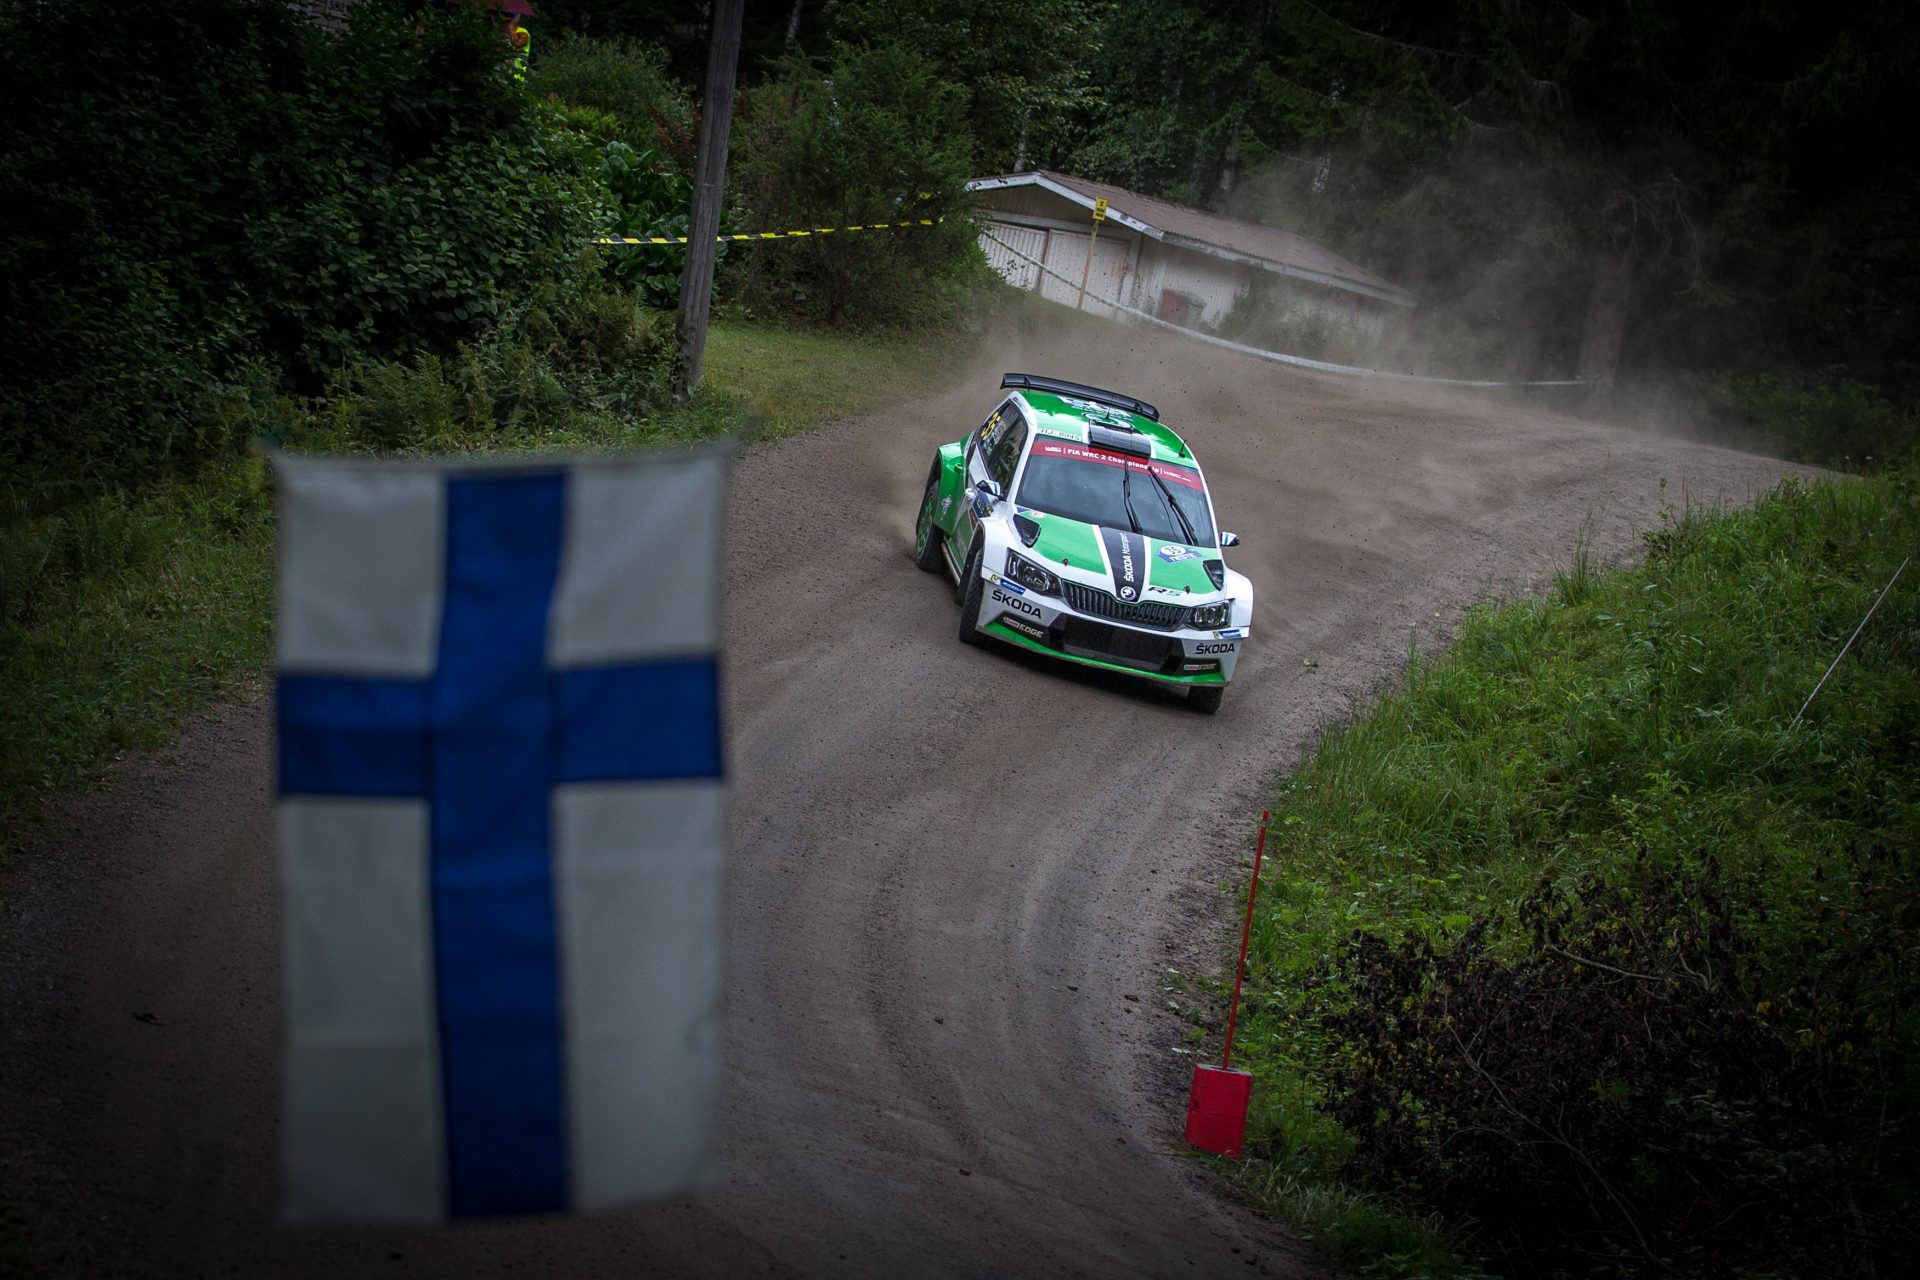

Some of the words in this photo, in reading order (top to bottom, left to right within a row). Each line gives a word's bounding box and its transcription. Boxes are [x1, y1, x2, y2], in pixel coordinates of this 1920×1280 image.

[1067, 447, 1081, 455] FIA
[1082, 450, 1099, 459] WRC
[1123, 555, 1135, 582] ŠKODA
[991, 589, 1042, 619] ŠKODA
[1019, 624, 1044, 638] EDGE
[1195, 643, 1235, 655] ŠKODA
